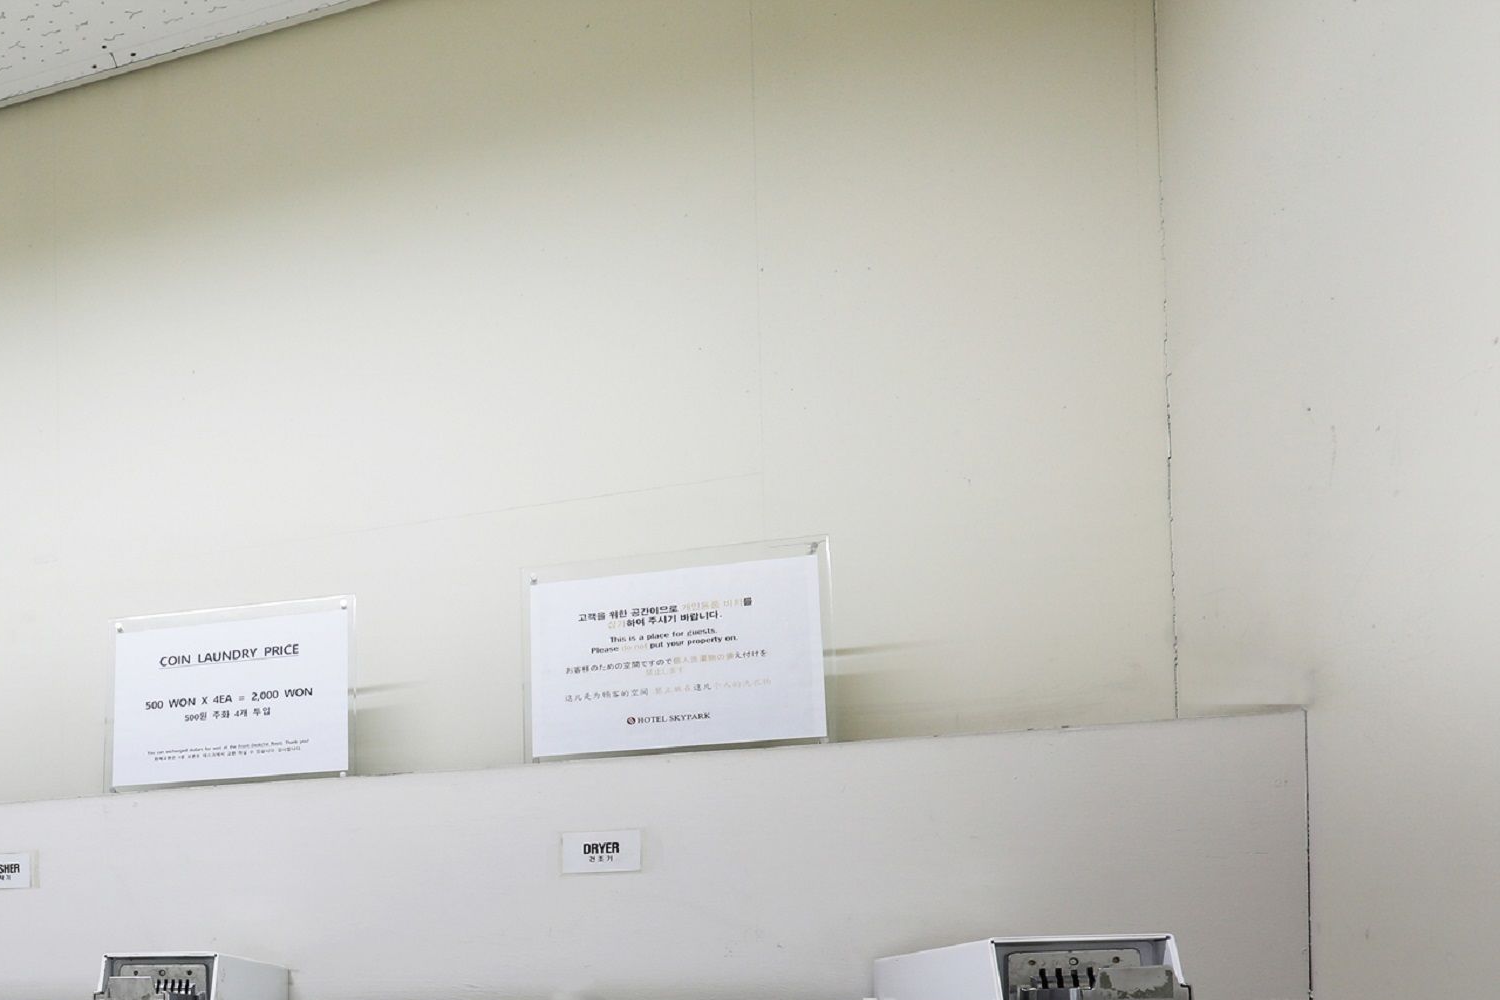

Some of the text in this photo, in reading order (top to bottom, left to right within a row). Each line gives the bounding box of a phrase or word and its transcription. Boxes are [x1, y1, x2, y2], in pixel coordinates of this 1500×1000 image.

[578, 612, 606, 622] 고객을
[609, 609, 627, 620] 위한
[648, 612, 677, 624] 주시기
[680, 610, 723, 622] 바랍니다.
[610, 635, 627, 643] This
[646, 631, 670, 641] place
[672, 630, 684, 638] for
[591, 645, 619, 655] Please
[649, 640, 664, 650] put
[666, 639, 684, 648] your
[687, 636, 723, 647] property
[159, 643, 300, 667] COIN LAUNDRY PRICE
[145, 700, 164, 710] 500
[168, 697, 197, 708] WON
[201, 696, 208, 705] X
[212, 694, 233, 704] 4EA
[251, 690, 279, 702] 2,000
[284, 687, 313, 698] WON
[184, 706, 271, 722] 500원 주화 4개 투입
[637, 712, 711, 724] HOTEL SKYPARK
[583, 841, 620, 855] DRYER
